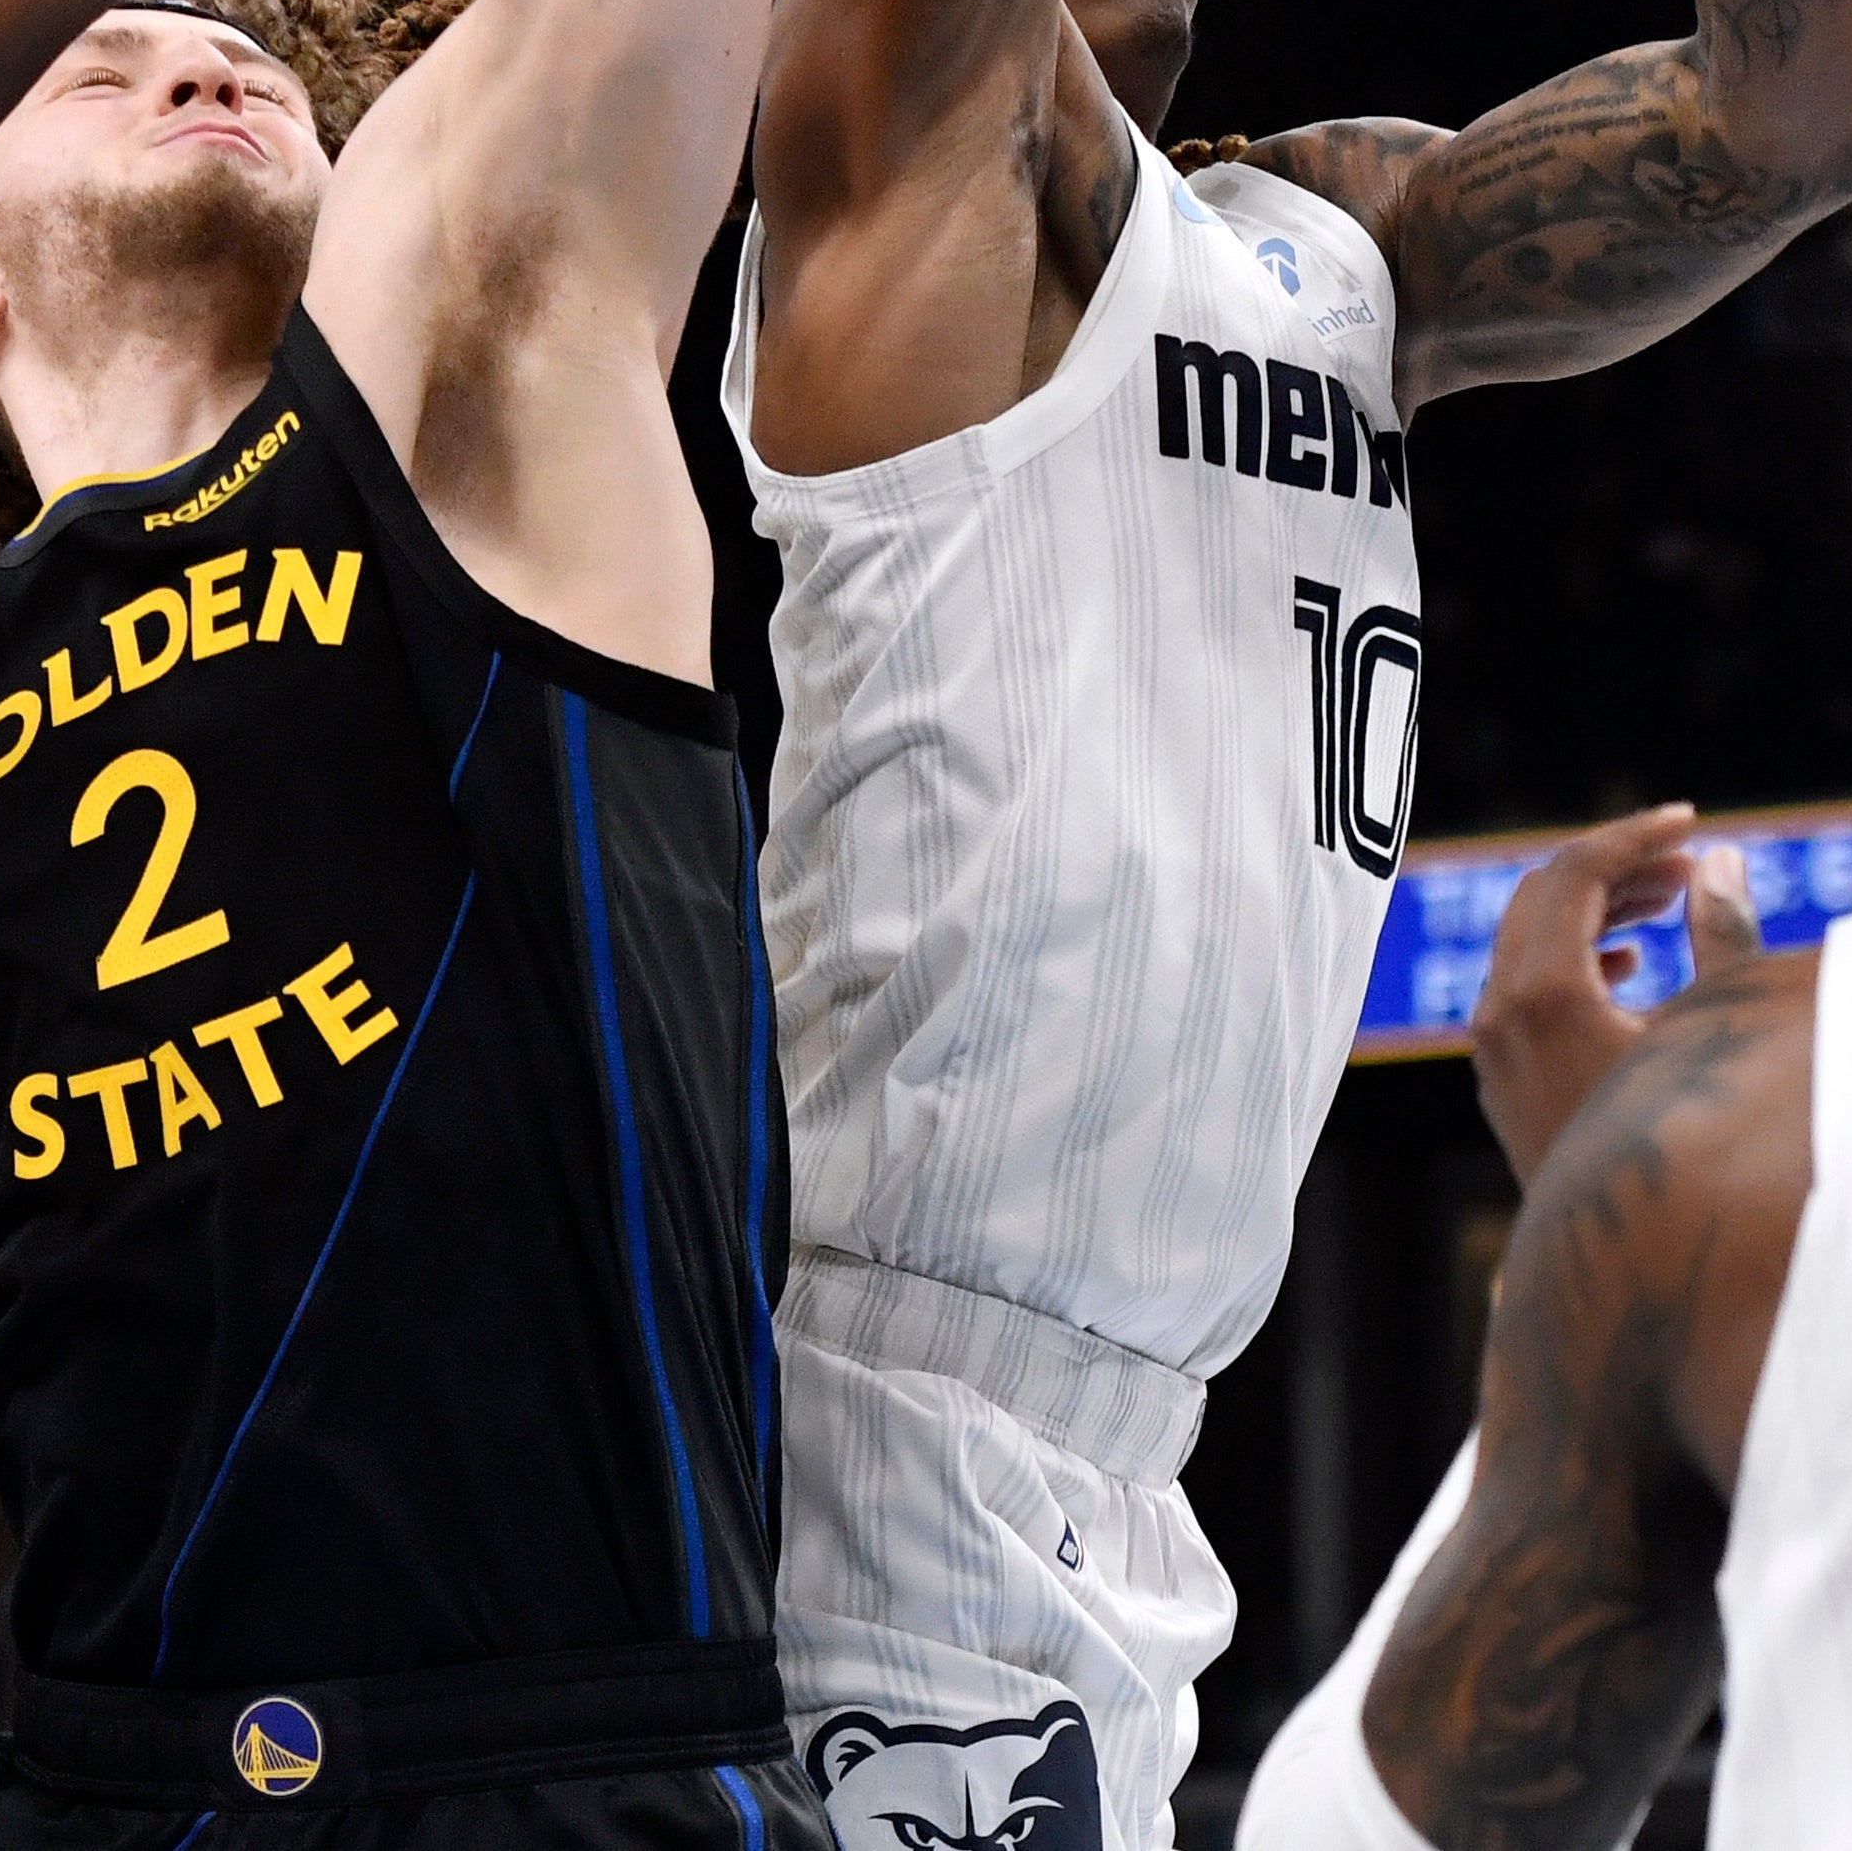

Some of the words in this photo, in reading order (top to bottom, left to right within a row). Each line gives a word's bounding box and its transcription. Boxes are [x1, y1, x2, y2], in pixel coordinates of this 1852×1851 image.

[143, 410, 301, 532] Rakuten
[1293, 575, 1424, 880] 10
[69, 748, 230, 990] 2
[10, 942, 399, 1181] STATE
